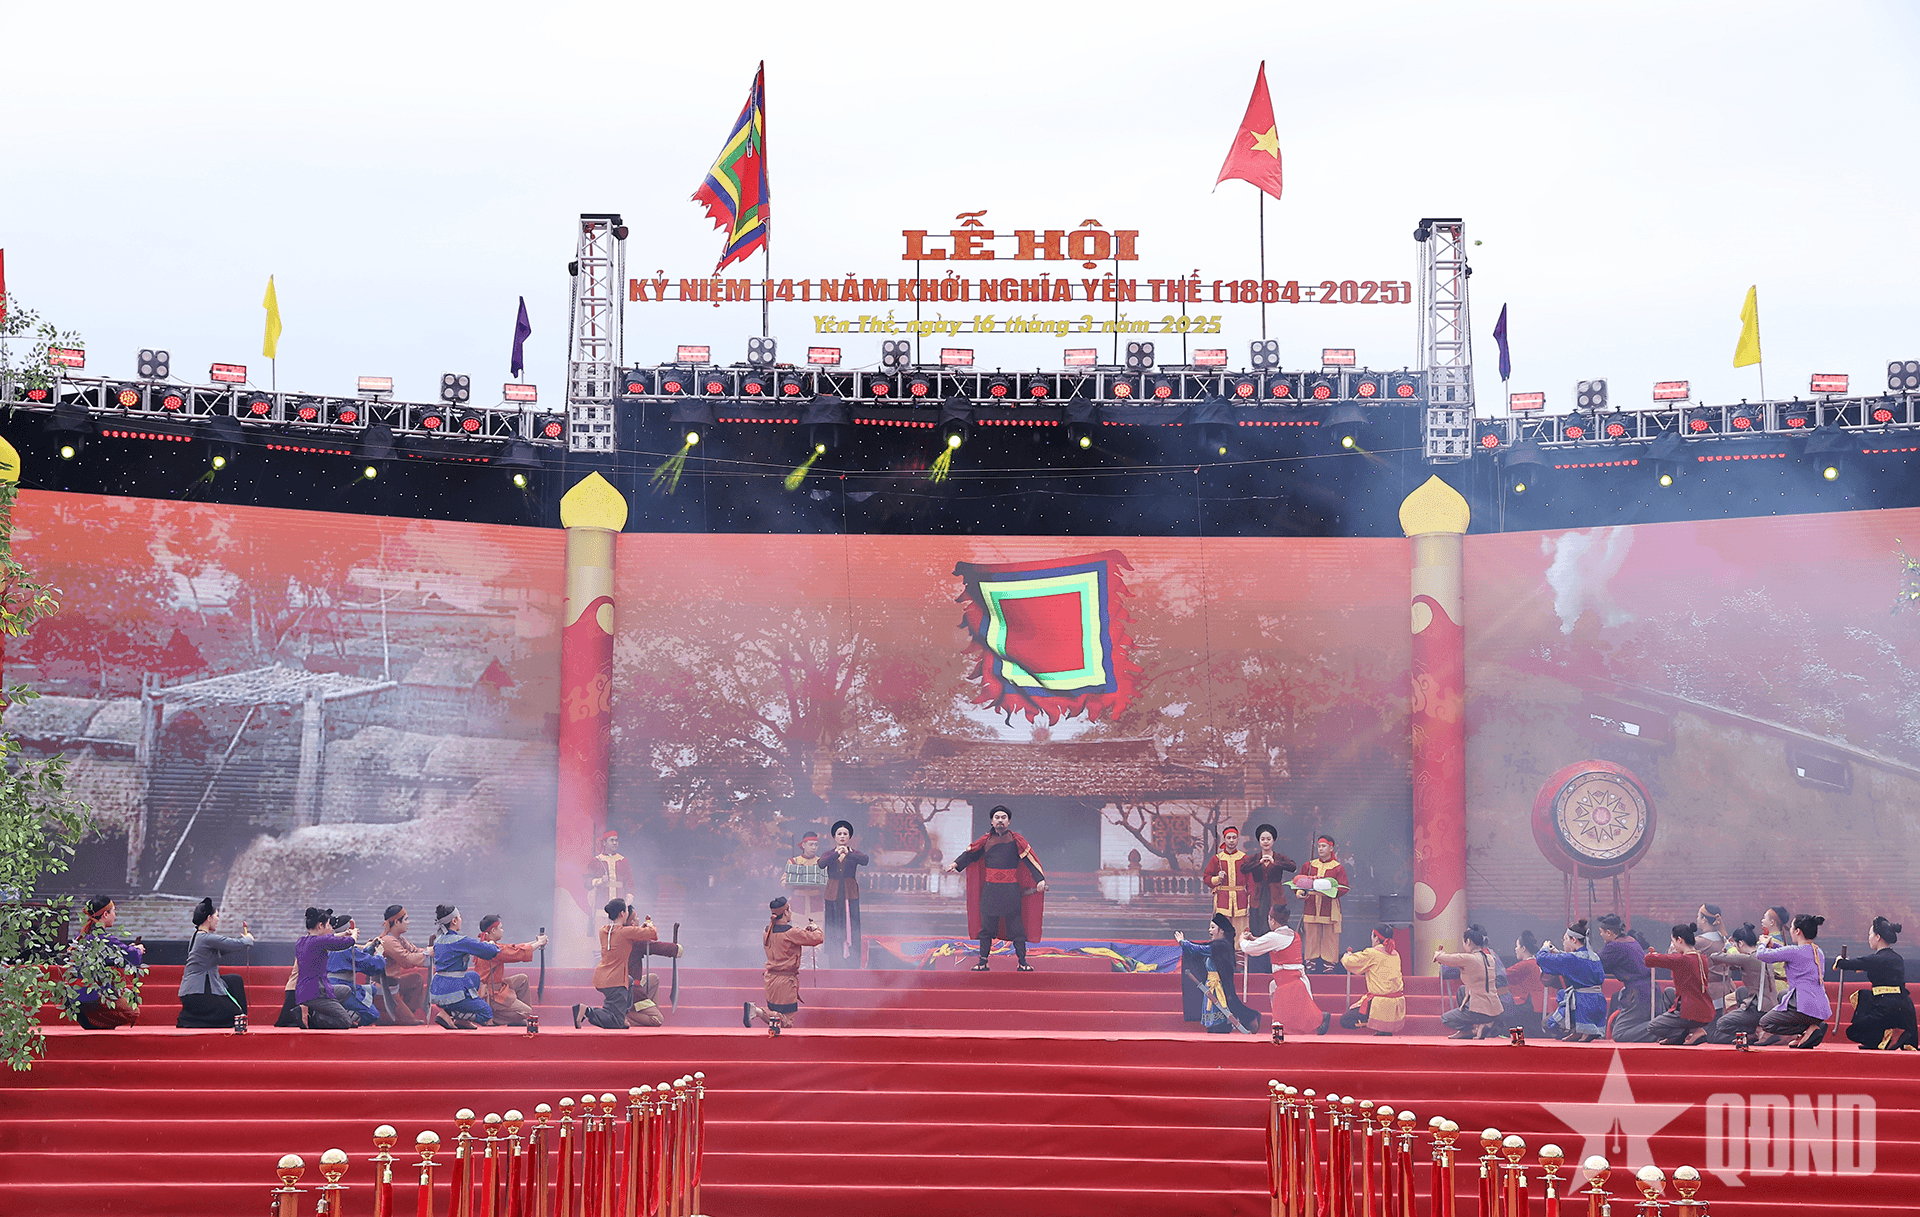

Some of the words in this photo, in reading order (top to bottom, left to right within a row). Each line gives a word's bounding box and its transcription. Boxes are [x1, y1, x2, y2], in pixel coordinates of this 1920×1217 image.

[901, 209, 996, 261] LỄ
[1013, 218, 1140, 270] HỘI
[629, 269, 670, 302] KỶ
[679, 273, 752, 308] NIỆM
[764, 278, 811, 302] 141
[820, 271, 888, 302] NĂM
[897, 269, 971, 302] KHỞI
[978, 271, 1073, 302] NGHĨA
[1083, 271, 1137, 303] YÊN
[1147, 268, 1204, 303] THẾ
[813, 314, 850, 334] Yên
[857, 309, 901, 336] Thế,
[905, 313, 964, 338] ngày
[971, 315, 998, 333] 16
[1005, 314, 1070, 338] tháng
[1078, 315, 1094, 334] 3
[1100, 313, 1150, 334] năm
[1160, 315, 1222, 334] 2025
